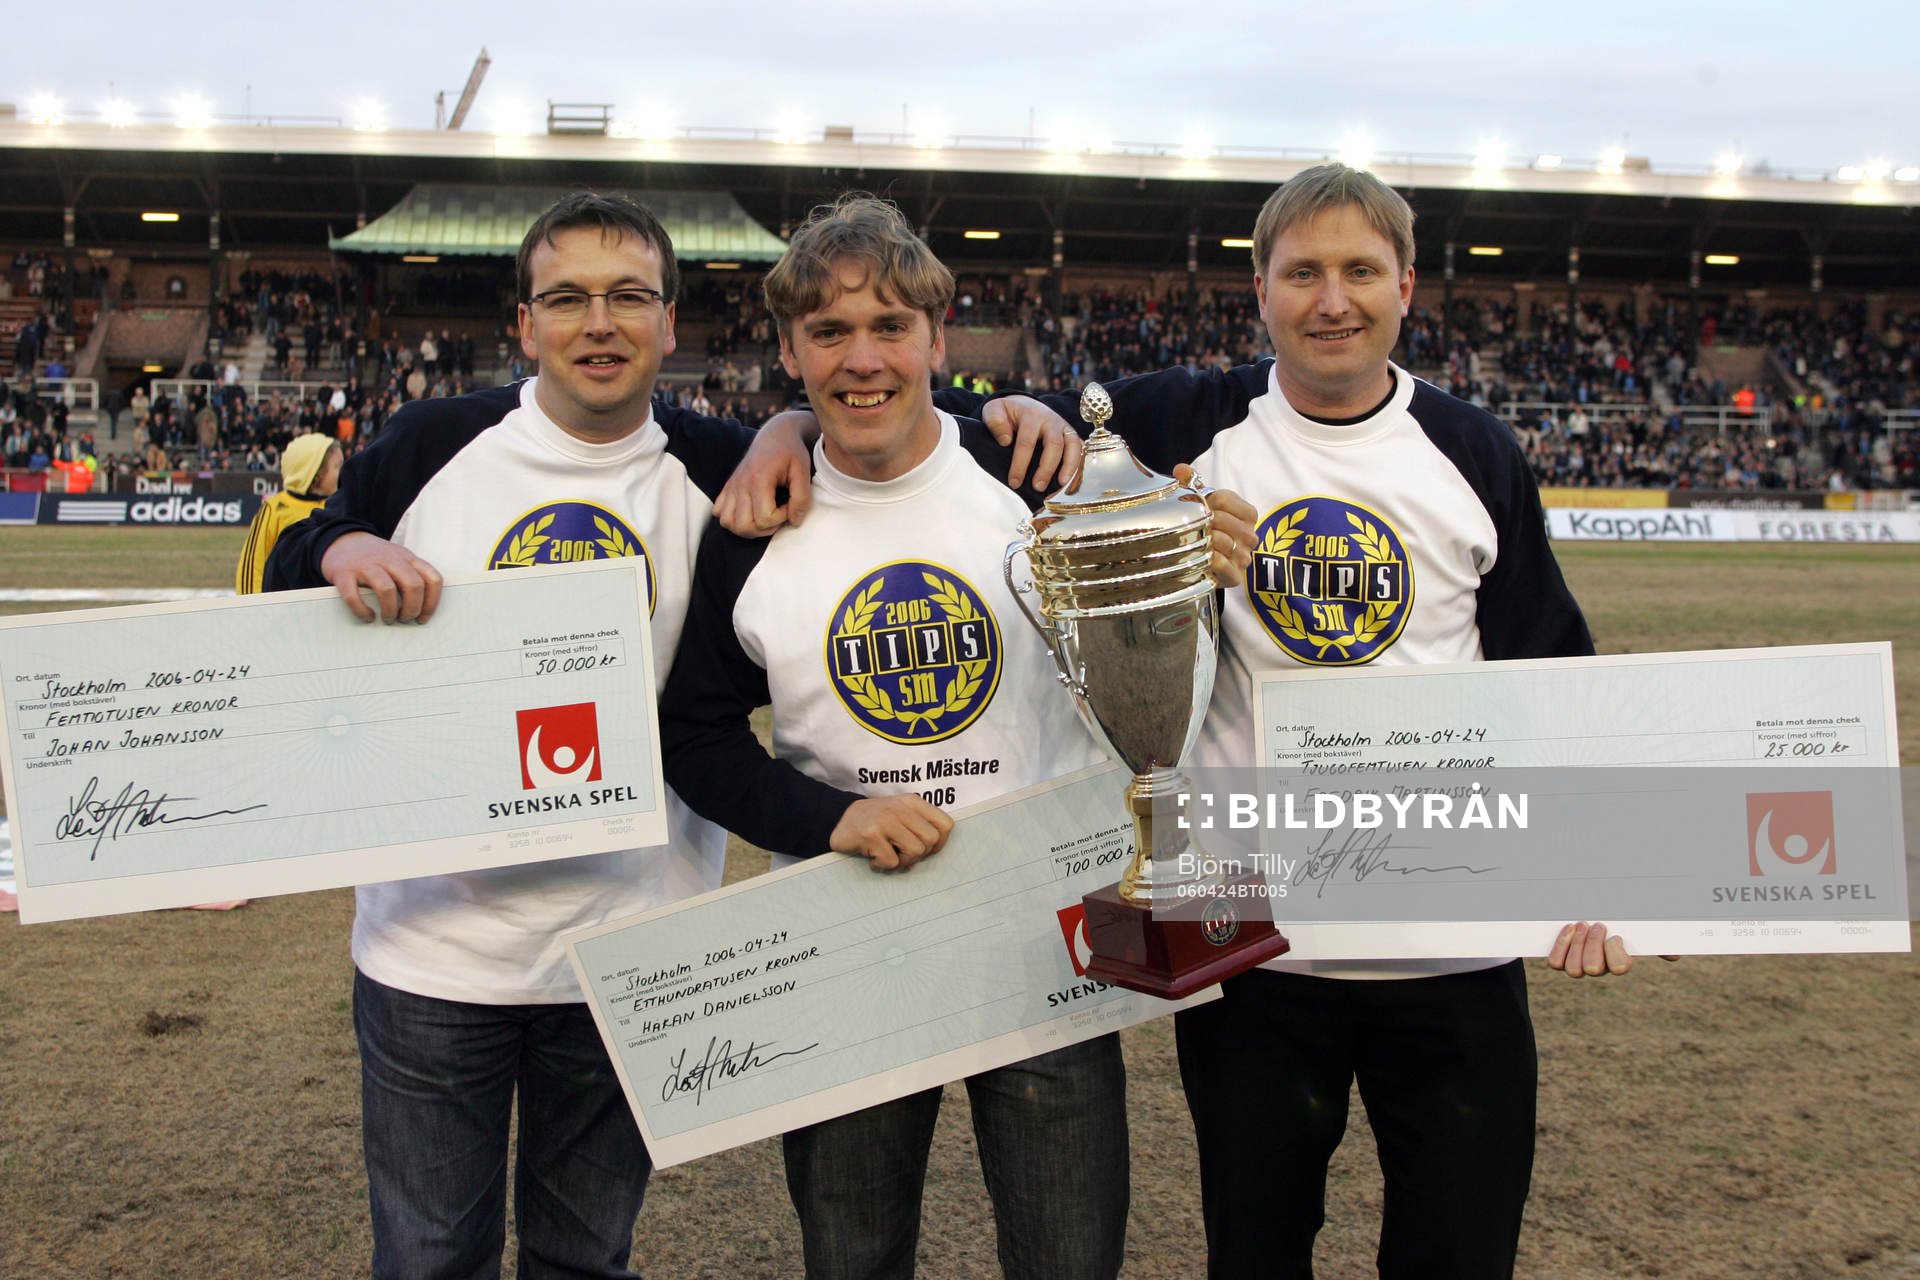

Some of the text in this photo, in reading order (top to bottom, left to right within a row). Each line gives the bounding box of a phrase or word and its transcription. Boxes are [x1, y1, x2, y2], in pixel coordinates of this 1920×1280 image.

[130, 496, 242, 522] adidas
[1568, 511, 1713, 540] KappAhl
[1758, 520, 1897, 541] FORESTA
[550, 539, 596, 562] 2006
[1305, 534, 1349, 558] 2006
[1262, 557, 1391, 599] TIPS
[885, 598, 932, 626] 2006
[1312, 603, 1349, 632] SM
[523, 638, 549, 646] Betala
[570, 632, 595, 640] denna
[597, 629, 619, 637] check
[525, 650, 551, 658] Kronor
[552, 647, 571, 656] (med
[844, 624, 979, 673] TIPS
[536, 653, 617, 675] 50.000 kr
[34, 673, 61, 681] datum
[42, 665, 250, 699] Stockholm 2006-04-24
[899, 672, 939, 706] SM
[19, 703, 47, 711] Kronor
[50, 702, 70, 710] (med
[171, 696, 239, 713] KRONOR
[1292, 724, 1315, 732] datum
[1807, 717, 1833, 725] denna
[1836, 716, 1861, 724] check
[46, 728, 224, 757] JOHAN JOHANSSON
[1298, 728, 1487, 748] Stockholm 2006-04-24
[1787, 732, 1807, 740] (med
[1810, 731, 1837, 739] siffror)
[1277, 752, 1302, 760] Kronor
[1304, 751, 1322, 759] (med
[1764, 741, 1850, 758] 25.000 kr
[26, 759, 72, 769] Underskrift
[858, 757, 999, 784] Svensk Mästare
[1301, 756, 1496, 776] TJUGOFEMTUSEN KRONOR
[488, 786, 638, 819] SVENSKA SPEL
[914, 787, 956, 807] 006
[1050, 822, 1134, 853] Betala mot denna che
[1055, 853, 1079, 864] Kronor
[1080, 846, 1099, 857] (med
[1712, 883, 1877, 903] SVENSKA SPEL
[626, 930, 788, 991] Stockholm 2006-04-24
[617, 967, 639, 977] datum
[634, 946, 820, 1012] ETTHUNDRATUSEN KRONOR
[610, 994, 634, 1004] Kronor
[703, 980, 796, 1016] DANIELSSON
[1047, 981, 1117, 1007] SVENS
